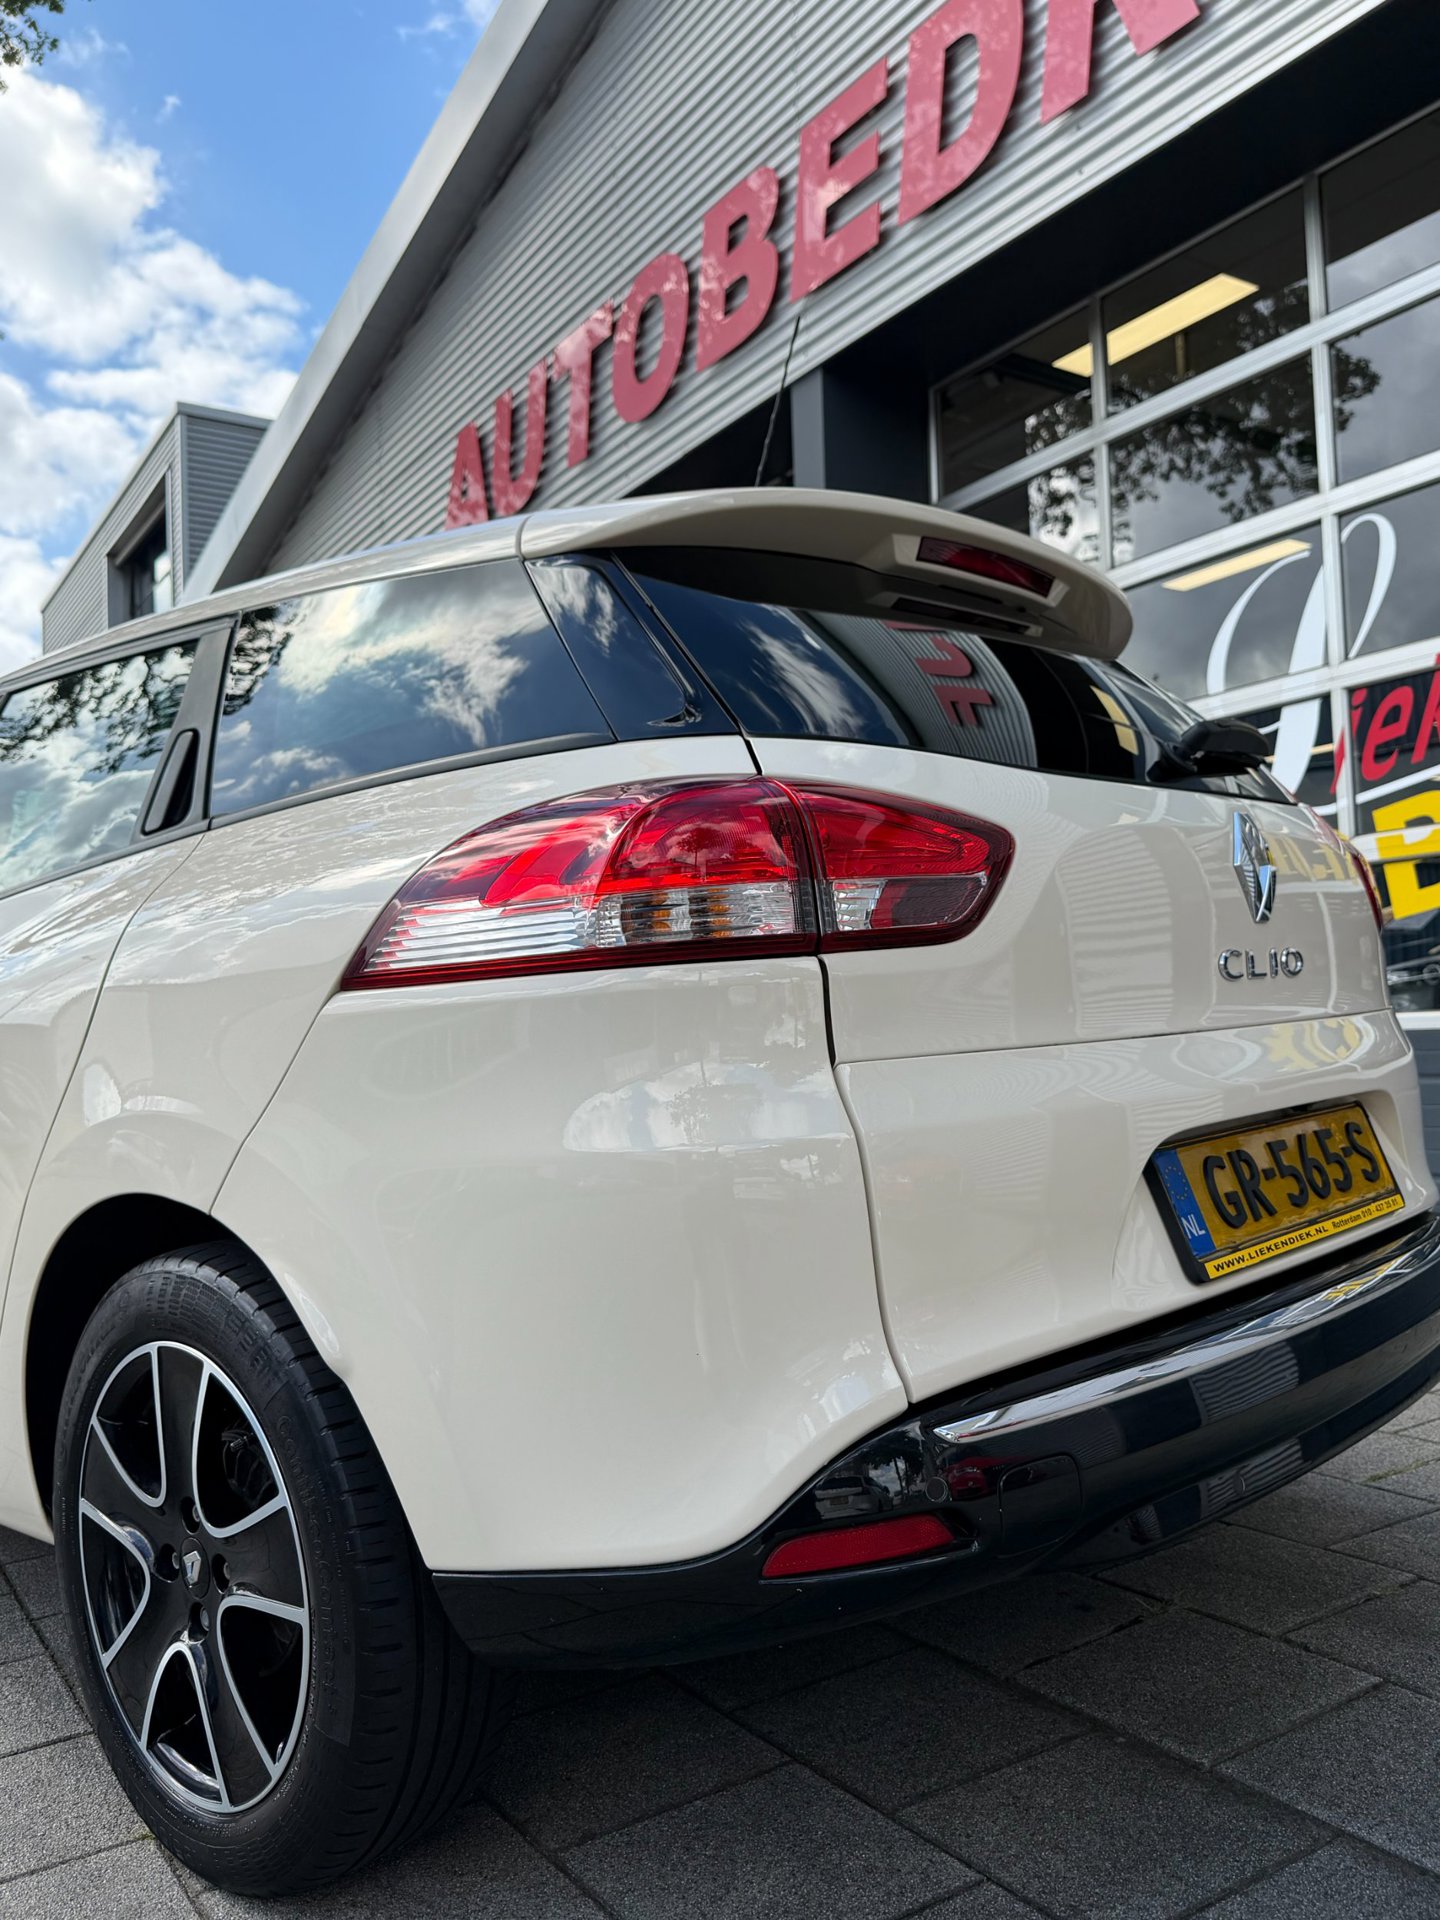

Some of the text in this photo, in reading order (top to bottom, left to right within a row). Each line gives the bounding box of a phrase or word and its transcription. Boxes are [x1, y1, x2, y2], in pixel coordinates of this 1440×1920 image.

[1218, 947, 1304, 982] CLIO
[1203, 1121, 1380, 1229] GR-565-S
[1181, 1213, 1206, 1239] NL
[1213, 1225, 1329, 1272] WWW.LIEKENDIEK.NL
[1331, 1213, 1362, 1230] Rotterdam
